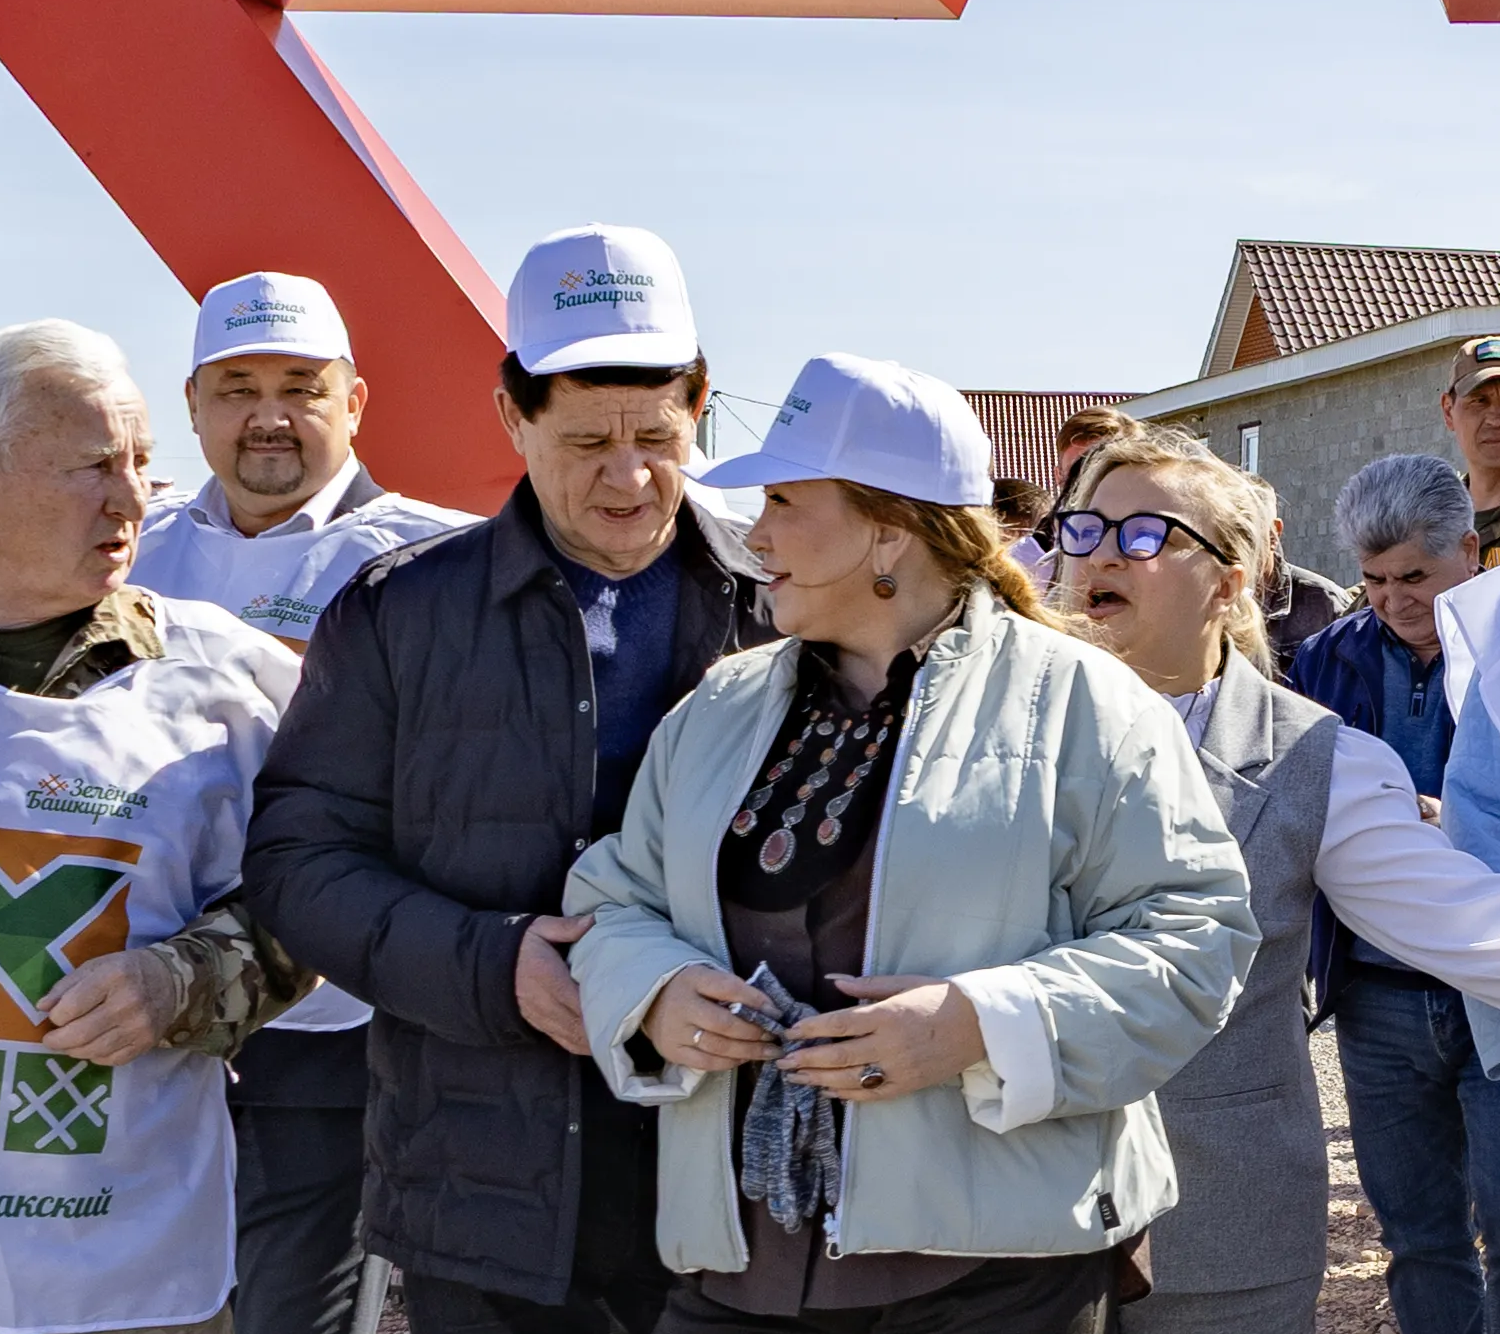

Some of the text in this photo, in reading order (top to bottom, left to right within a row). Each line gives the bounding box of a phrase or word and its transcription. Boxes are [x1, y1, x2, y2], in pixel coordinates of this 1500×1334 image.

[585, 269, 655, 287] Зелёная
[250, 299, 306, 315] Зелёная
[553, 290, 646, 310] Башкирия
[224, 313, 298, 331] Башкирия
[69, 777, 150, 809] Зелёная
[26, 789, 134, 826] Башкирия
